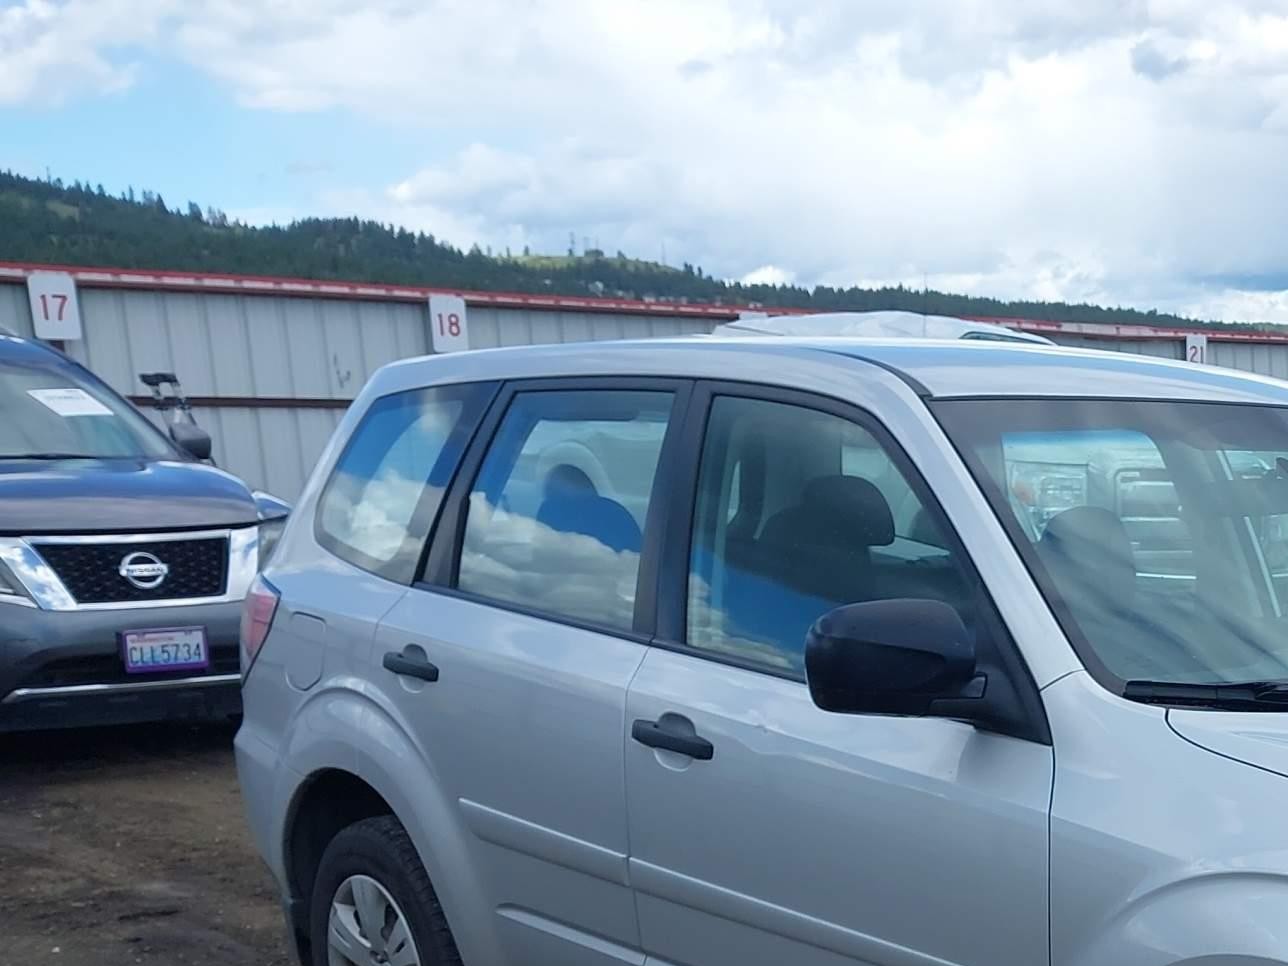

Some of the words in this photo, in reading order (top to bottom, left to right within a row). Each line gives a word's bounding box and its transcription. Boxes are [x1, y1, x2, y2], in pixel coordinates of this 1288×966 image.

[40, 294, 68, 321] 17
[437, 313, 461, 337] 18
[1189, 345, 1204, 364] 21
[129, 642, 202, 665] CLL5734
